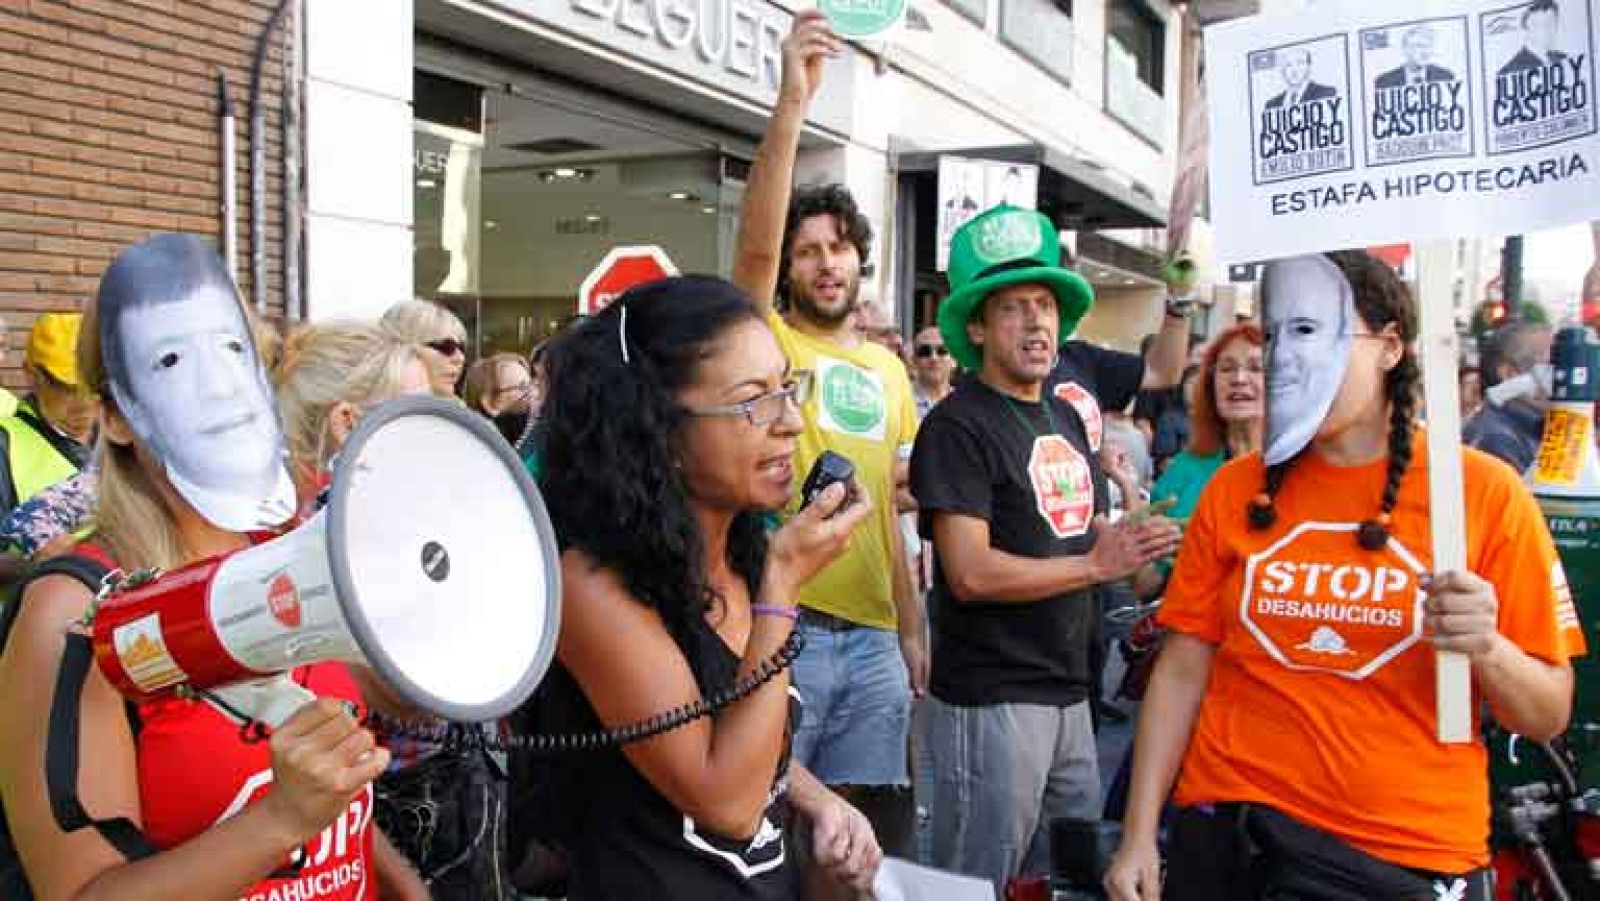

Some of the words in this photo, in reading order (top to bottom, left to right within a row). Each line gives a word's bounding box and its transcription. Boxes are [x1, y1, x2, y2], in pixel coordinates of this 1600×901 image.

[1496, 63, 1564, 101] JUICIO
[1567, 54, 1584, 82] Y
[1262, 101, 1323, 135] JUICIO
[1326, 96, 1342, 121] Y
[1374, 82, 1441, 117] JUICIO
[1446, 80, 1462, 106] Y
[1494, 81, 1586, 127] CASTIGO
[1260, 121, 1344, 158] CASTIGO
[1372, 104, 1464, 139] CASTIGO
[1271, 181, 1377, 216] ESTAFA
[1384, 152, 1589, 201] HIPOTECARIA
[1260, 561, 1409, 602] STOP
[1257, 598, 1402, 627] DESAHUCIOS
